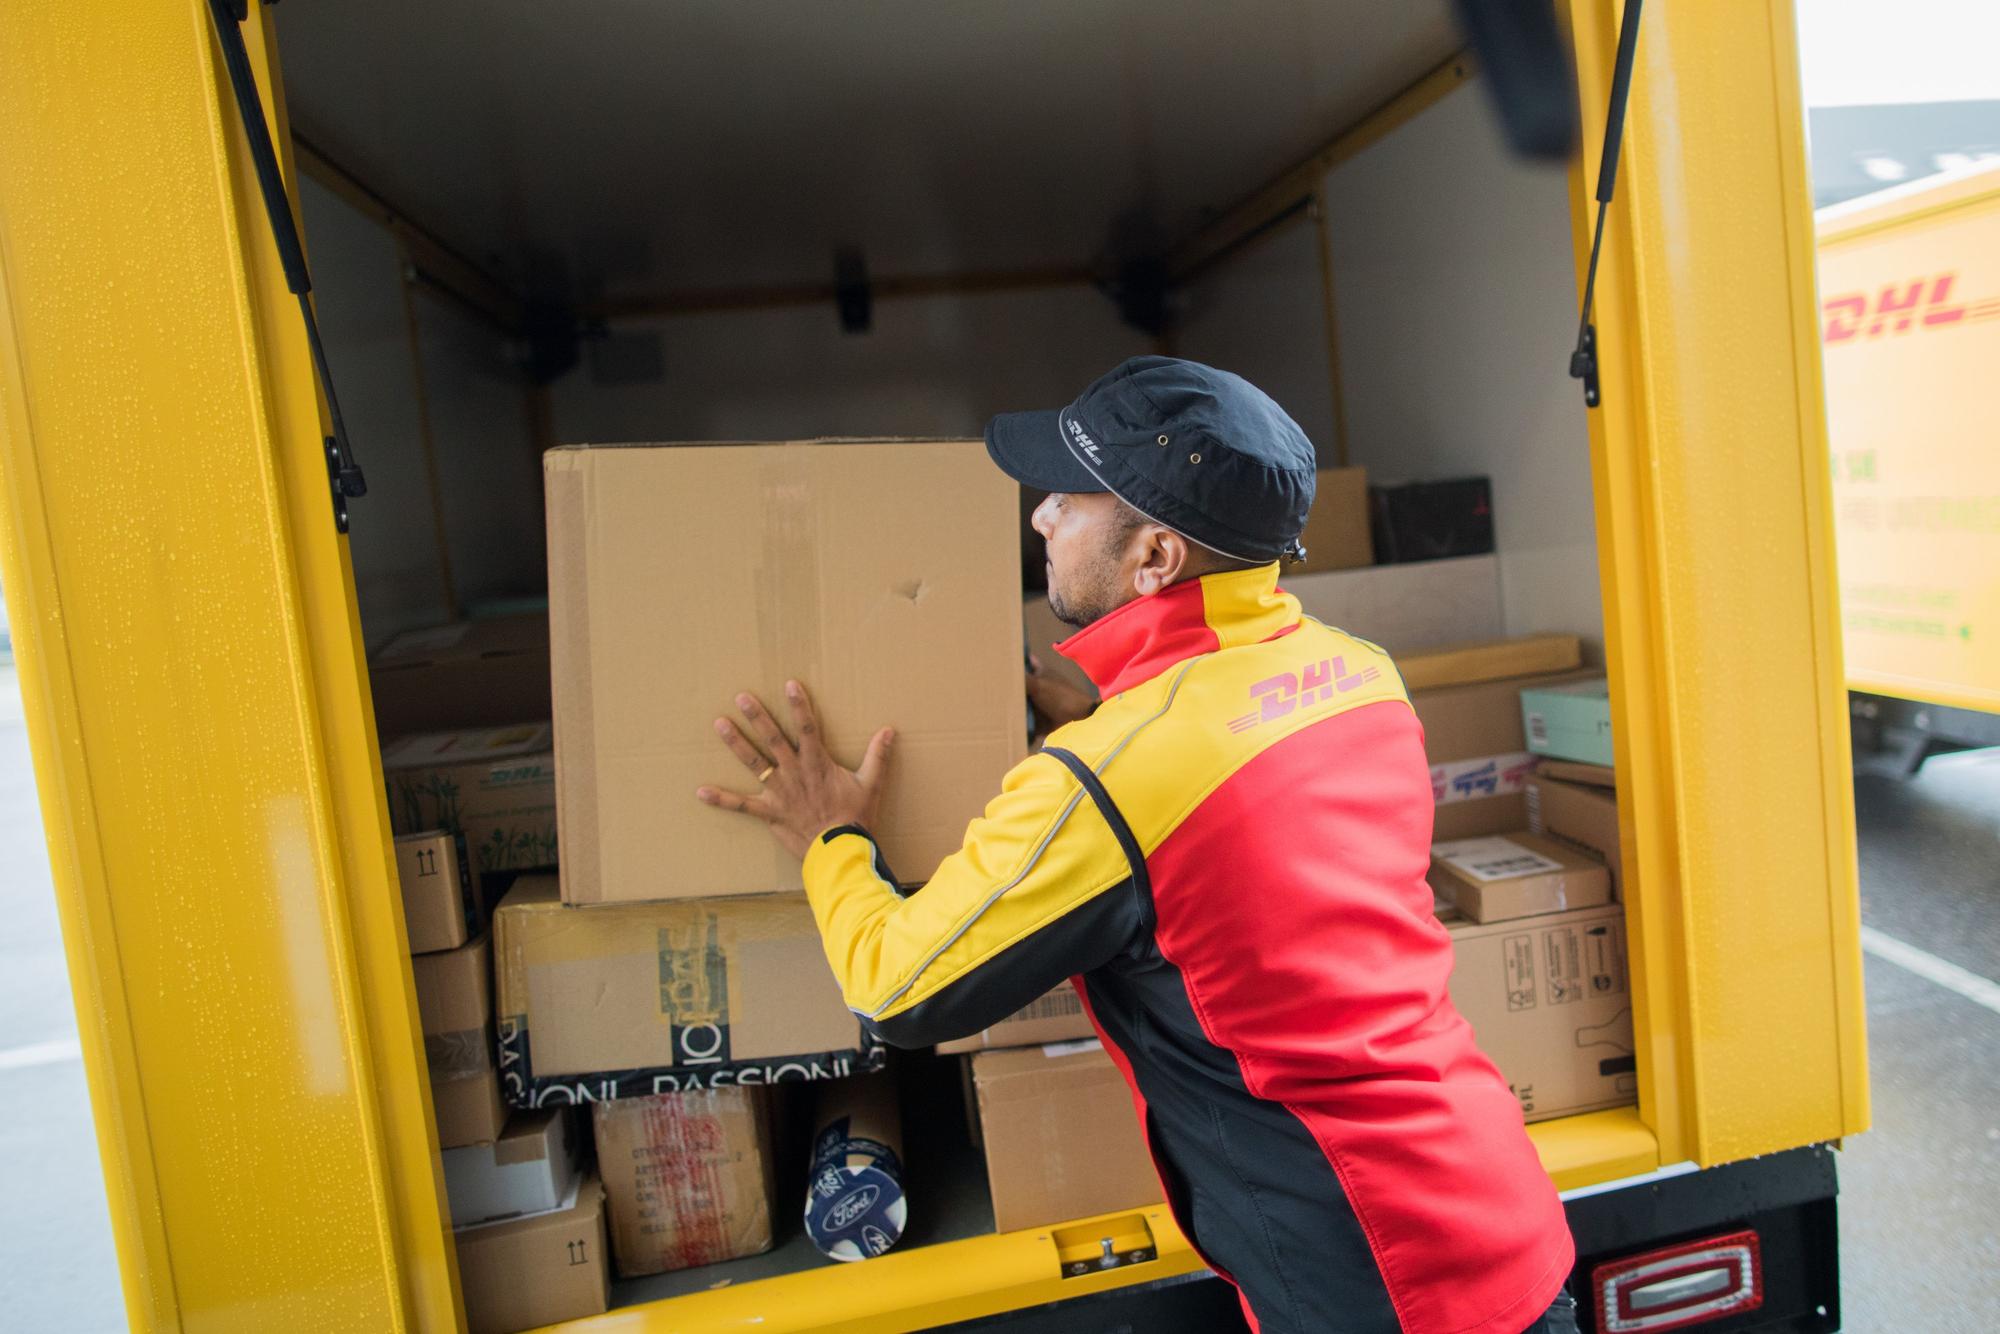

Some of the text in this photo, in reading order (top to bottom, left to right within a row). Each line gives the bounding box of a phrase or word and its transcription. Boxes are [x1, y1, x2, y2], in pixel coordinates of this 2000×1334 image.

[1824, 276, 1966, 342] DHL
[1068, 420, 1099, 459] DHL
[1250, 656, 1363, 722] DHL
[834, 1192, 871, 1227] Ford
